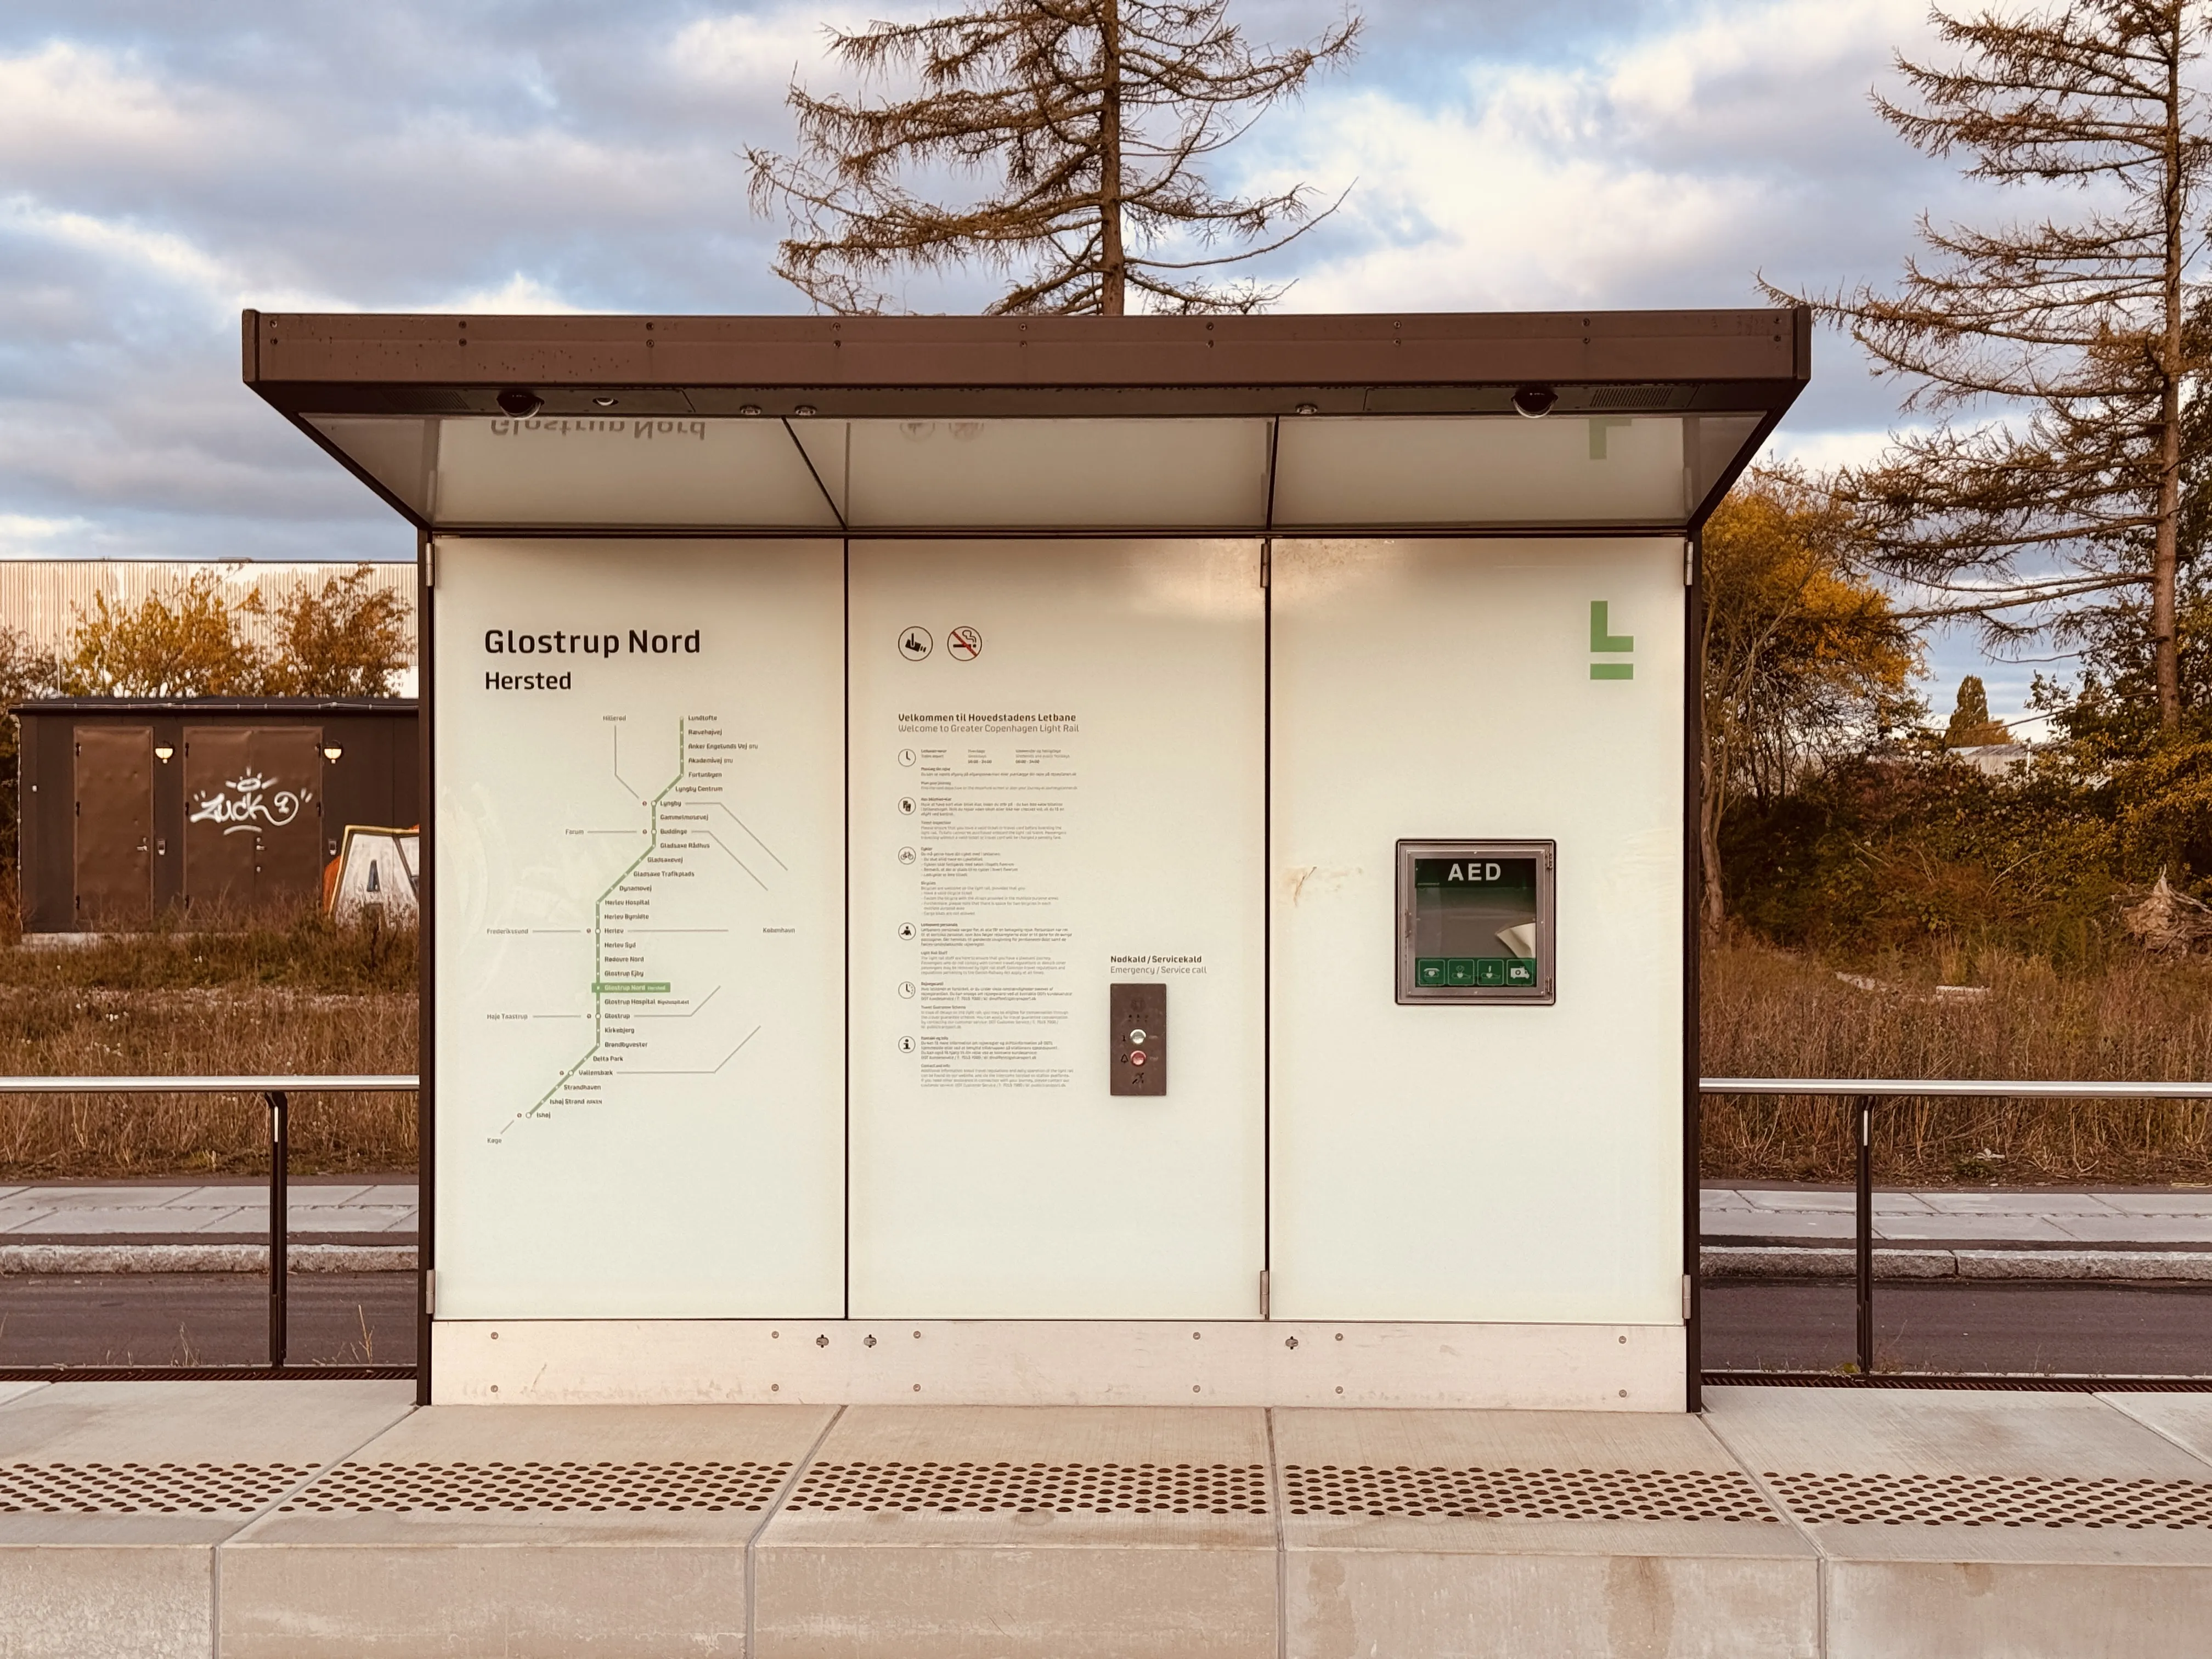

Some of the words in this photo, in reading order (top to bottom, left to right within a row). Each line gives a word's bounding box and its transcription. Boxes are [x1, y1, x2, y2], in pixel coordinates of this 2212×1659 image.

[485, 629, 619, 658] Glostrup
[629, 629, 699, 653] Nord
[486, 671, 571, 690] Hersted
[898, 713, 953, 721] Velkommen
[956, 713, 966, 721] til
[968, 713, 1036, 721] Hovedstadens
[1038, 713, 1075, 721] Letbane
[985, 724, 1037, 733] Copenhagen
[1040, 724, 1060, 733] Light
[1063, 724, 1079, 732] Rail
[1447, 863, 1501, 881] AED
[1147, 955, 1150, 964] /
[1110, 966, 1155, 975] Emergency
[1156, 966, 1160, 974] /
[1161, 965, 1190, 973] Service
